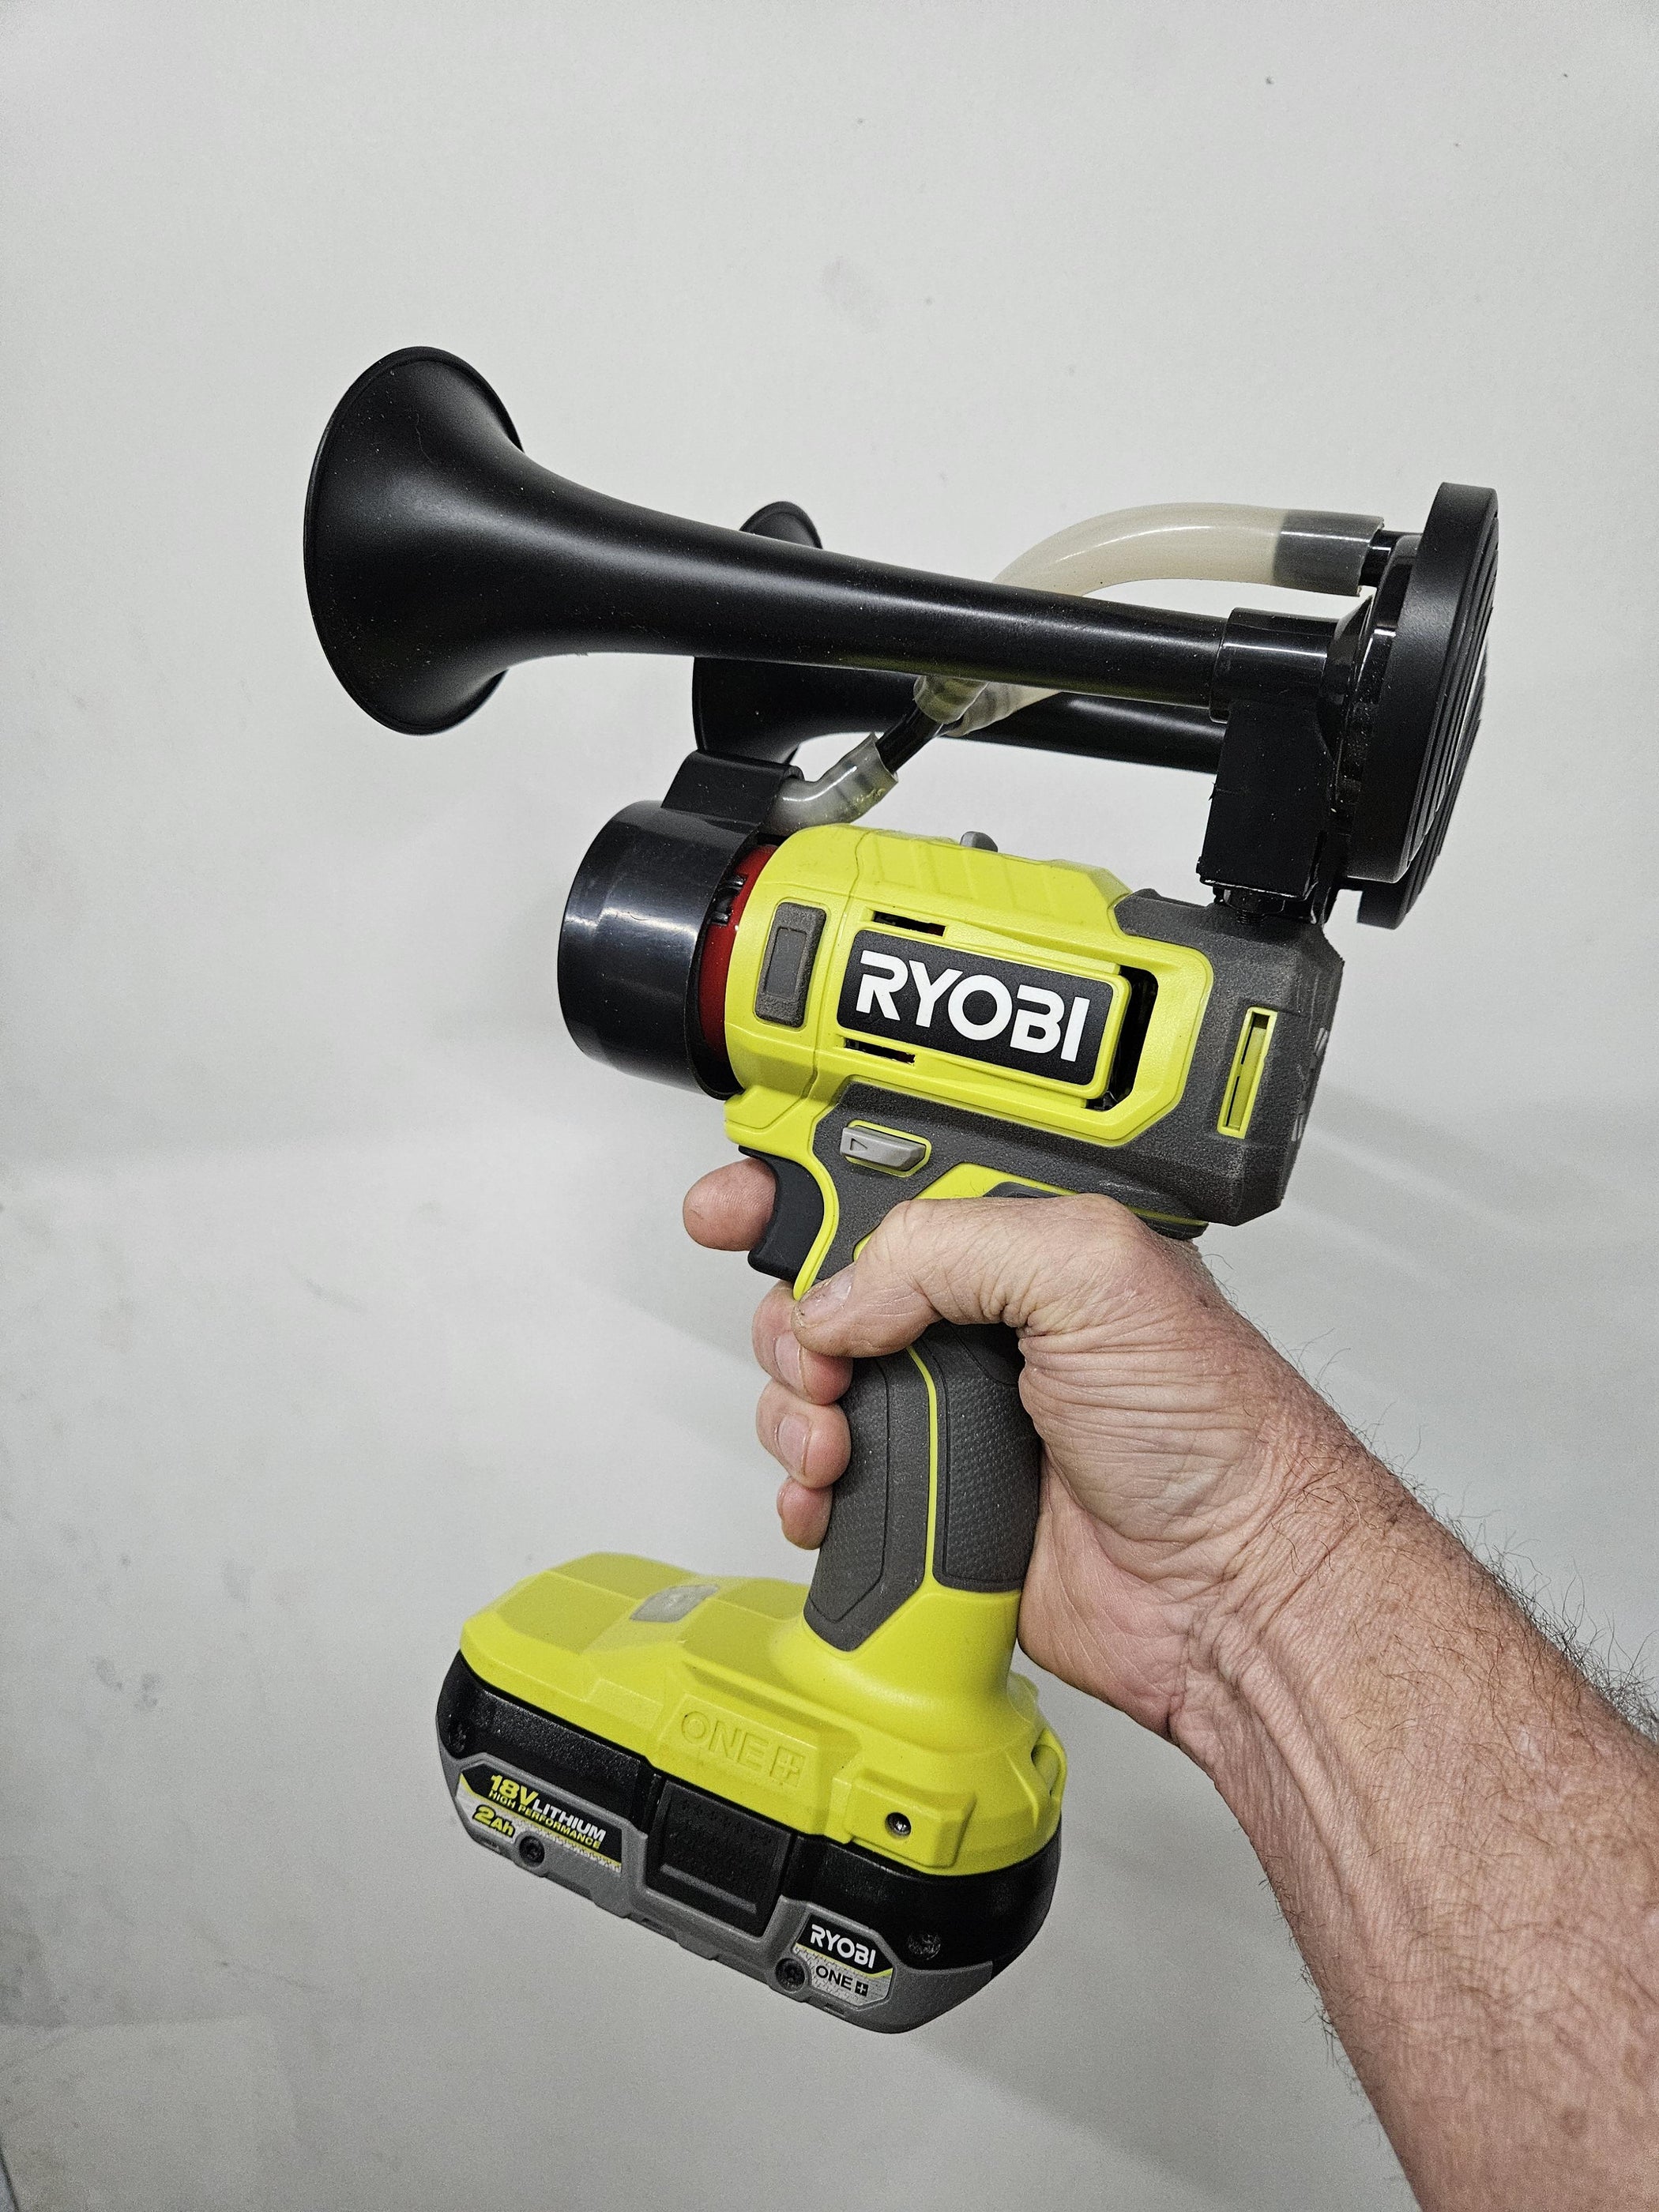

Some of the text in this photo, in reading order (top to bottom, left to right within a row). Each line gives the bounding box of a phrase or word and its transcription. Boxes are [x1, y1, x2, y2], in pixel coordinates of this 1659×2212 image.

[856, 950, 1090, 1063] RYOBI
[472, 1804, 516, 1838] 2Ah
[488, 1789, 602, 1850] HIGH PERFORMANCE
[810, 1924, 876, 1969] RYOBI
